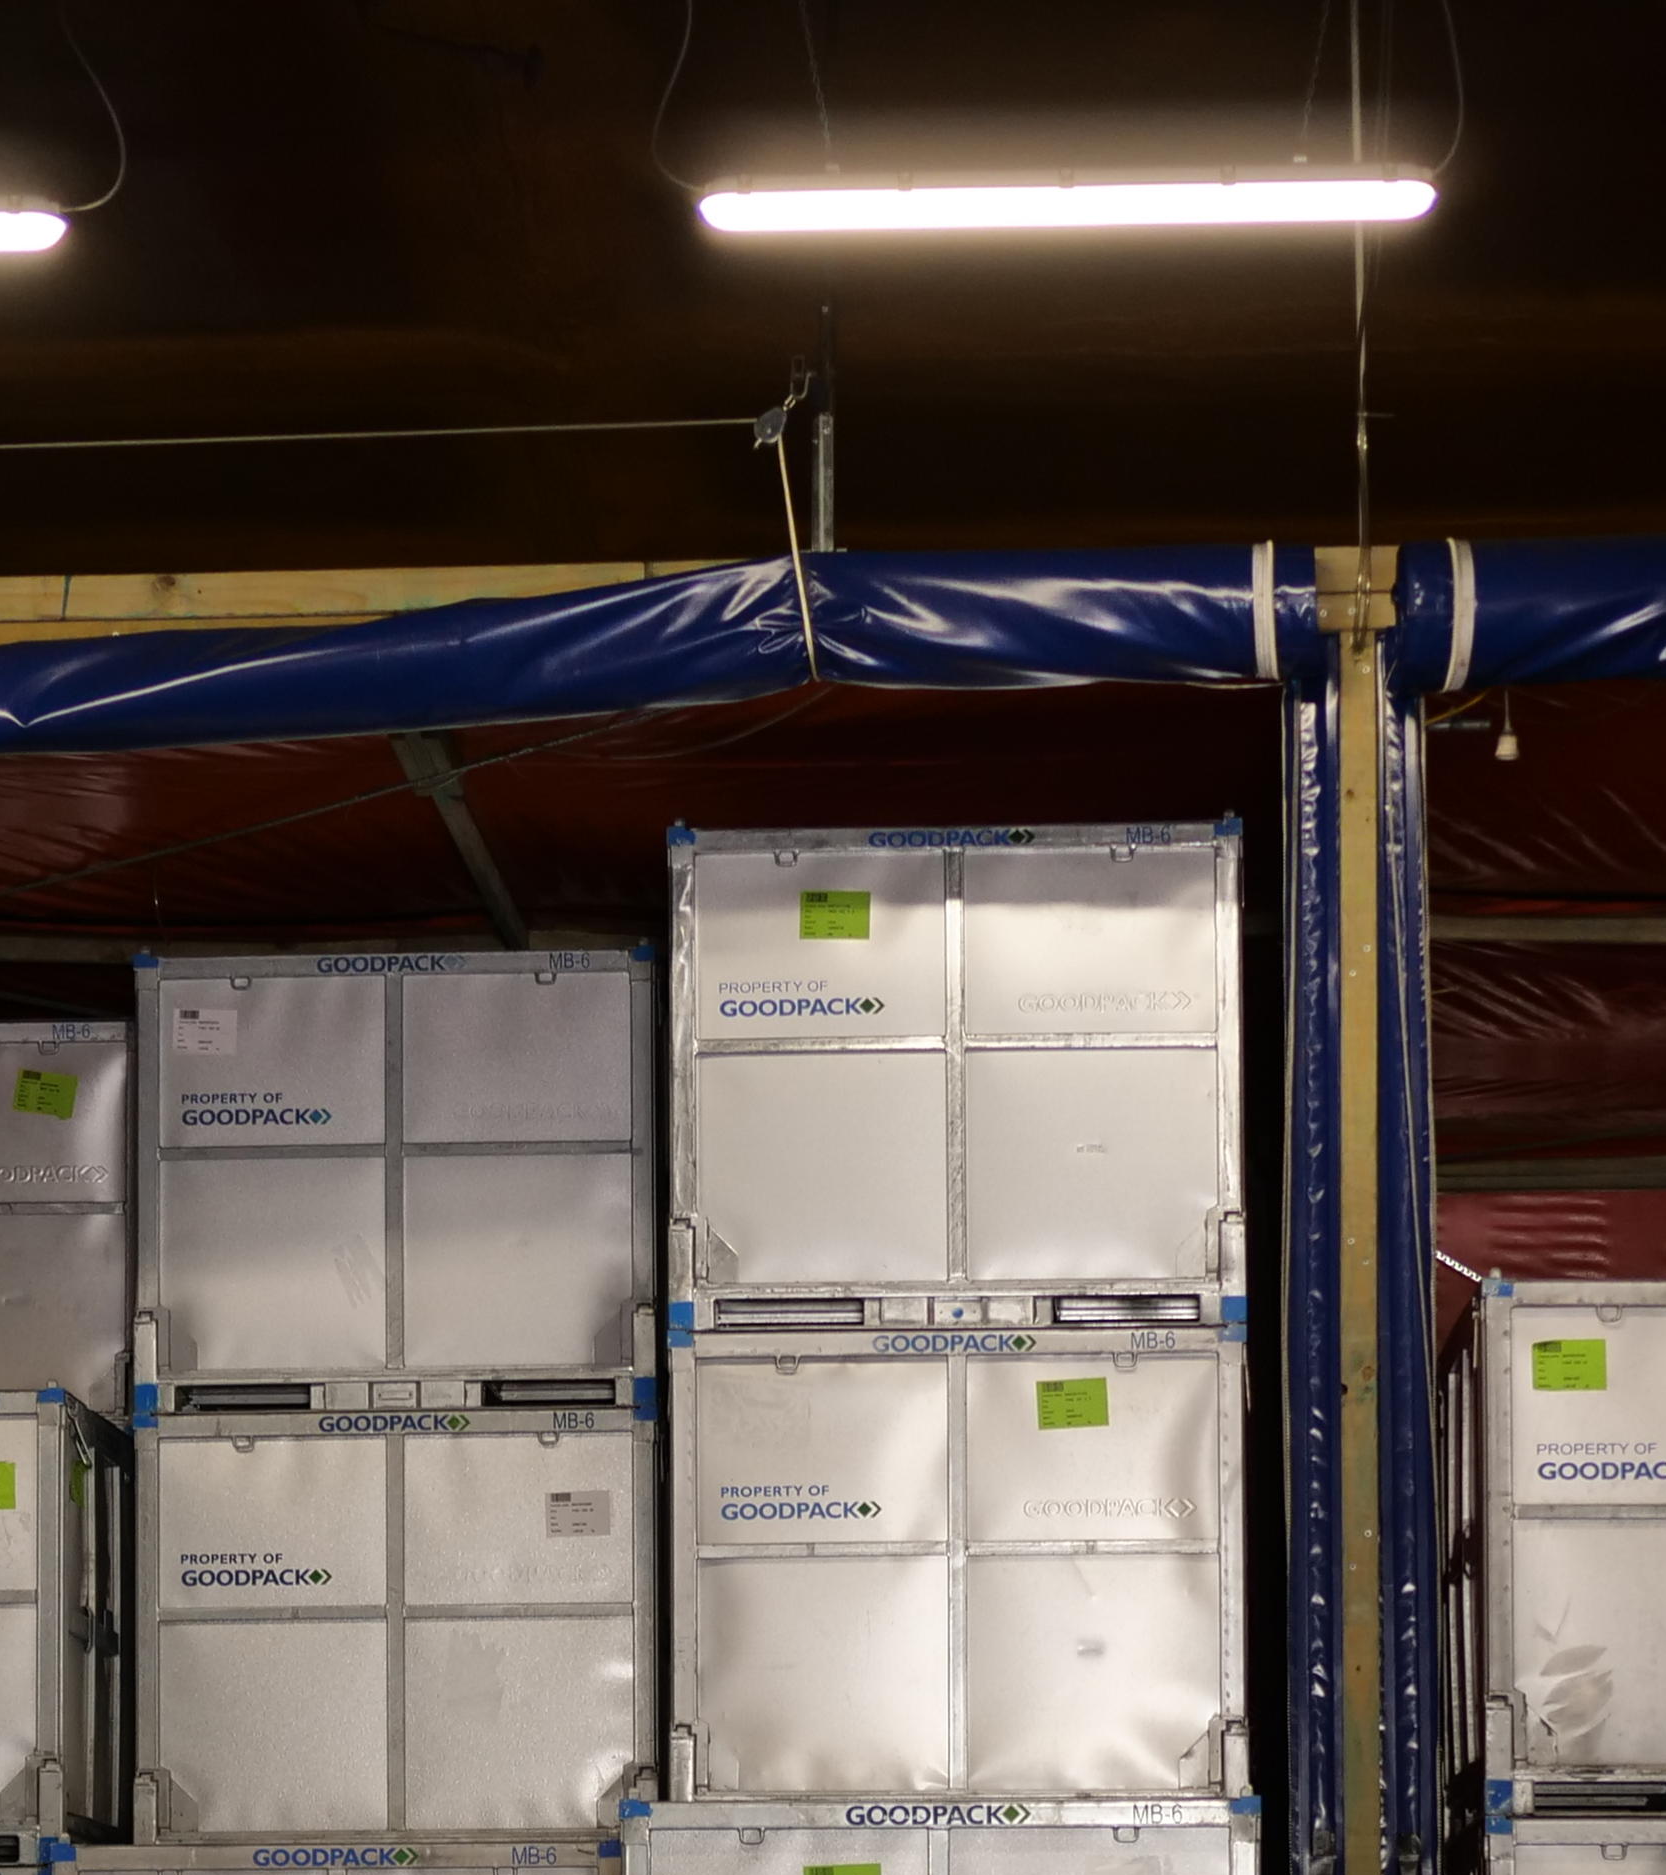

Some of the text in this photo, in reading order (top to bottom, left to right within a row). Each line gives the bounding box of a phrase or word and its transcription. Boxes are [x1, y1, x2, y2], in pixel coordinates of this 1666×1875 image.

[869, 826, 1171, 848] GOODPACK MB-6
[316, 953, 590, 973] GOODPACK MB-6
[719, 981, 829, 994] PROPERTY OF
[720, 998, 859, 1017] GOODPACK
[52, 1024, 91, 1041] MB-6
[181, 1092, 283, 1104] PROPERTY OF
[181, 1109, 310, 1126] GOODPACK
[872, 1332, 1175, 1353] GOODPACK MB-6
[319, 1412, 594, 1432] GOODPACK MB-6
[1537, 1443, 1657, 1455] PROPERTY OF
[720, 1485, 829, 1498] PROPERTY OF
[721, 1502, 857, 1521] GOODPACK
[180, 1553, 284, 1565] PROPERTY OF
[181, 1569, 310, 1586] GOODPACK
[845, 1804, 1183, 1826] GOODPACK MB-6
[253, 1847, 557, 1866] GOODPACK MB-6
